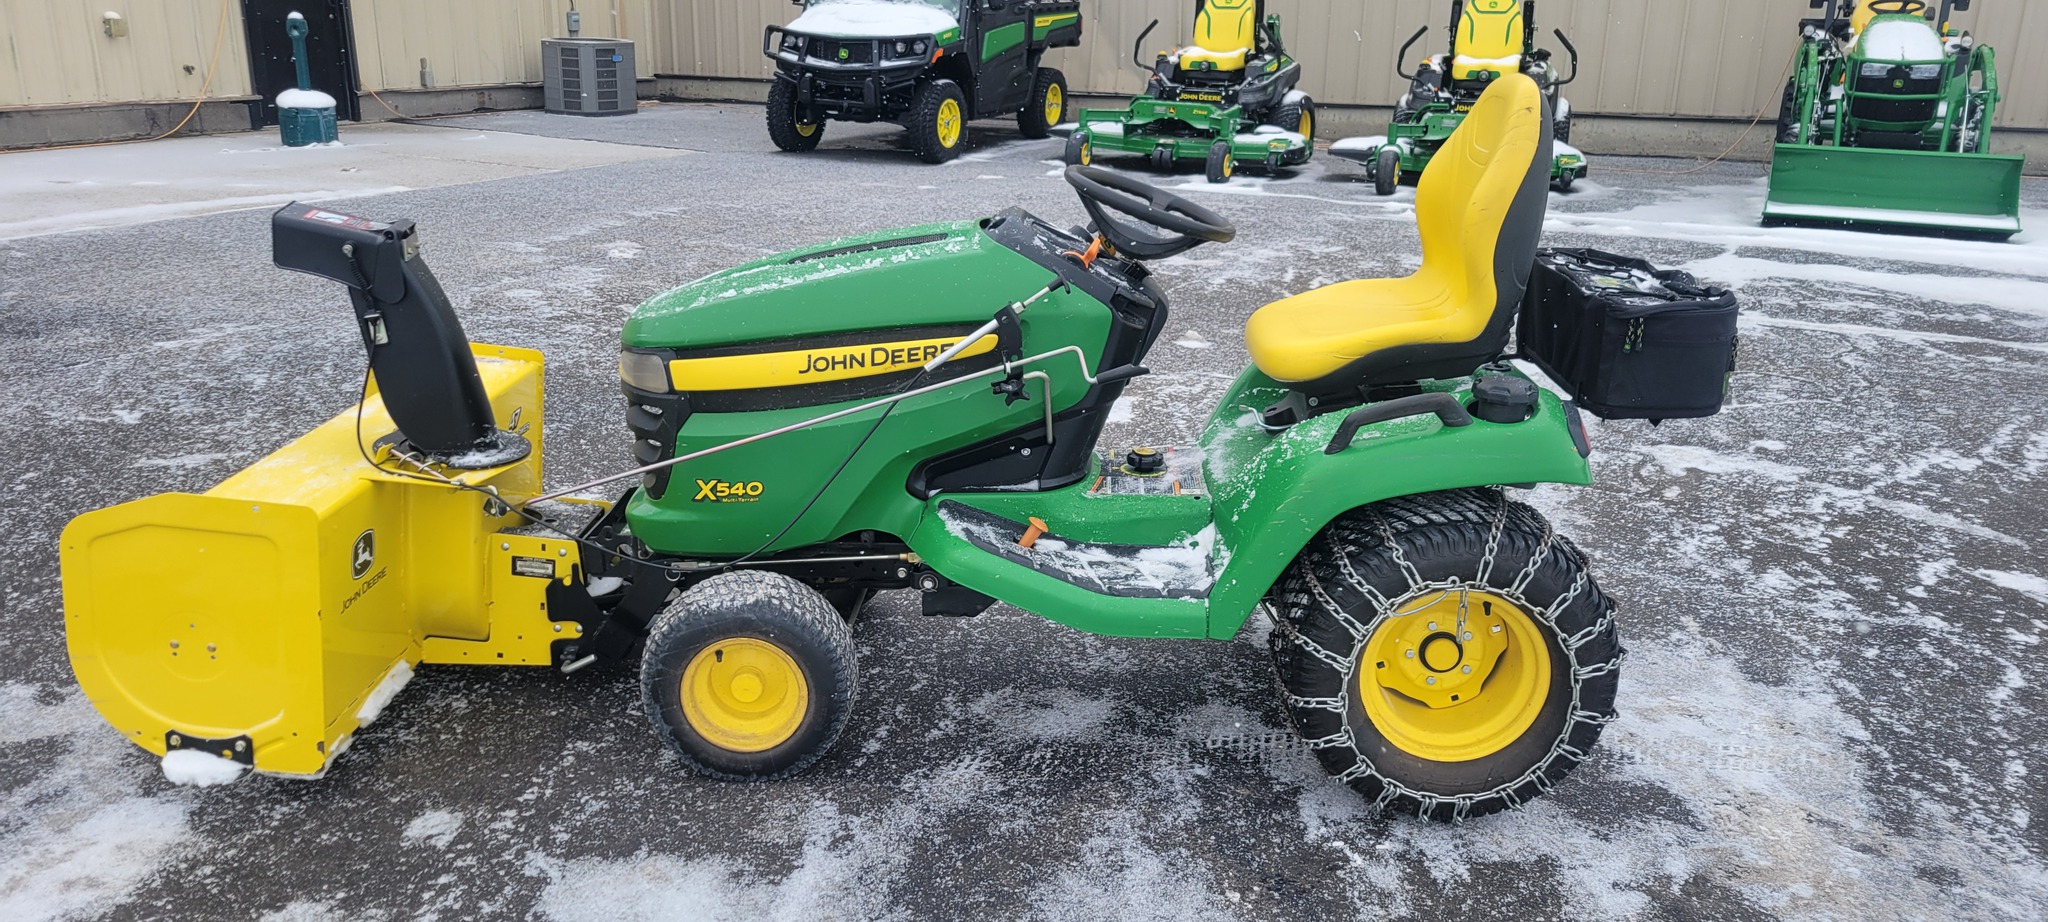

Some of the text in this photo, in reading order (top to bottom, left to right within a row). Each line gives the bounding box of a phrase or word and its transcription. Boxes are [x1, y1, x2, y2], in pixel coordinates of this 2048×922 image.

[1179, 92, 1222, 102] JOHN DEERE
[798, 352, 865, 374] JOHN
[693, 479, 764, 501] X540
[340, 565, 387, 615] JOHN DEERE
